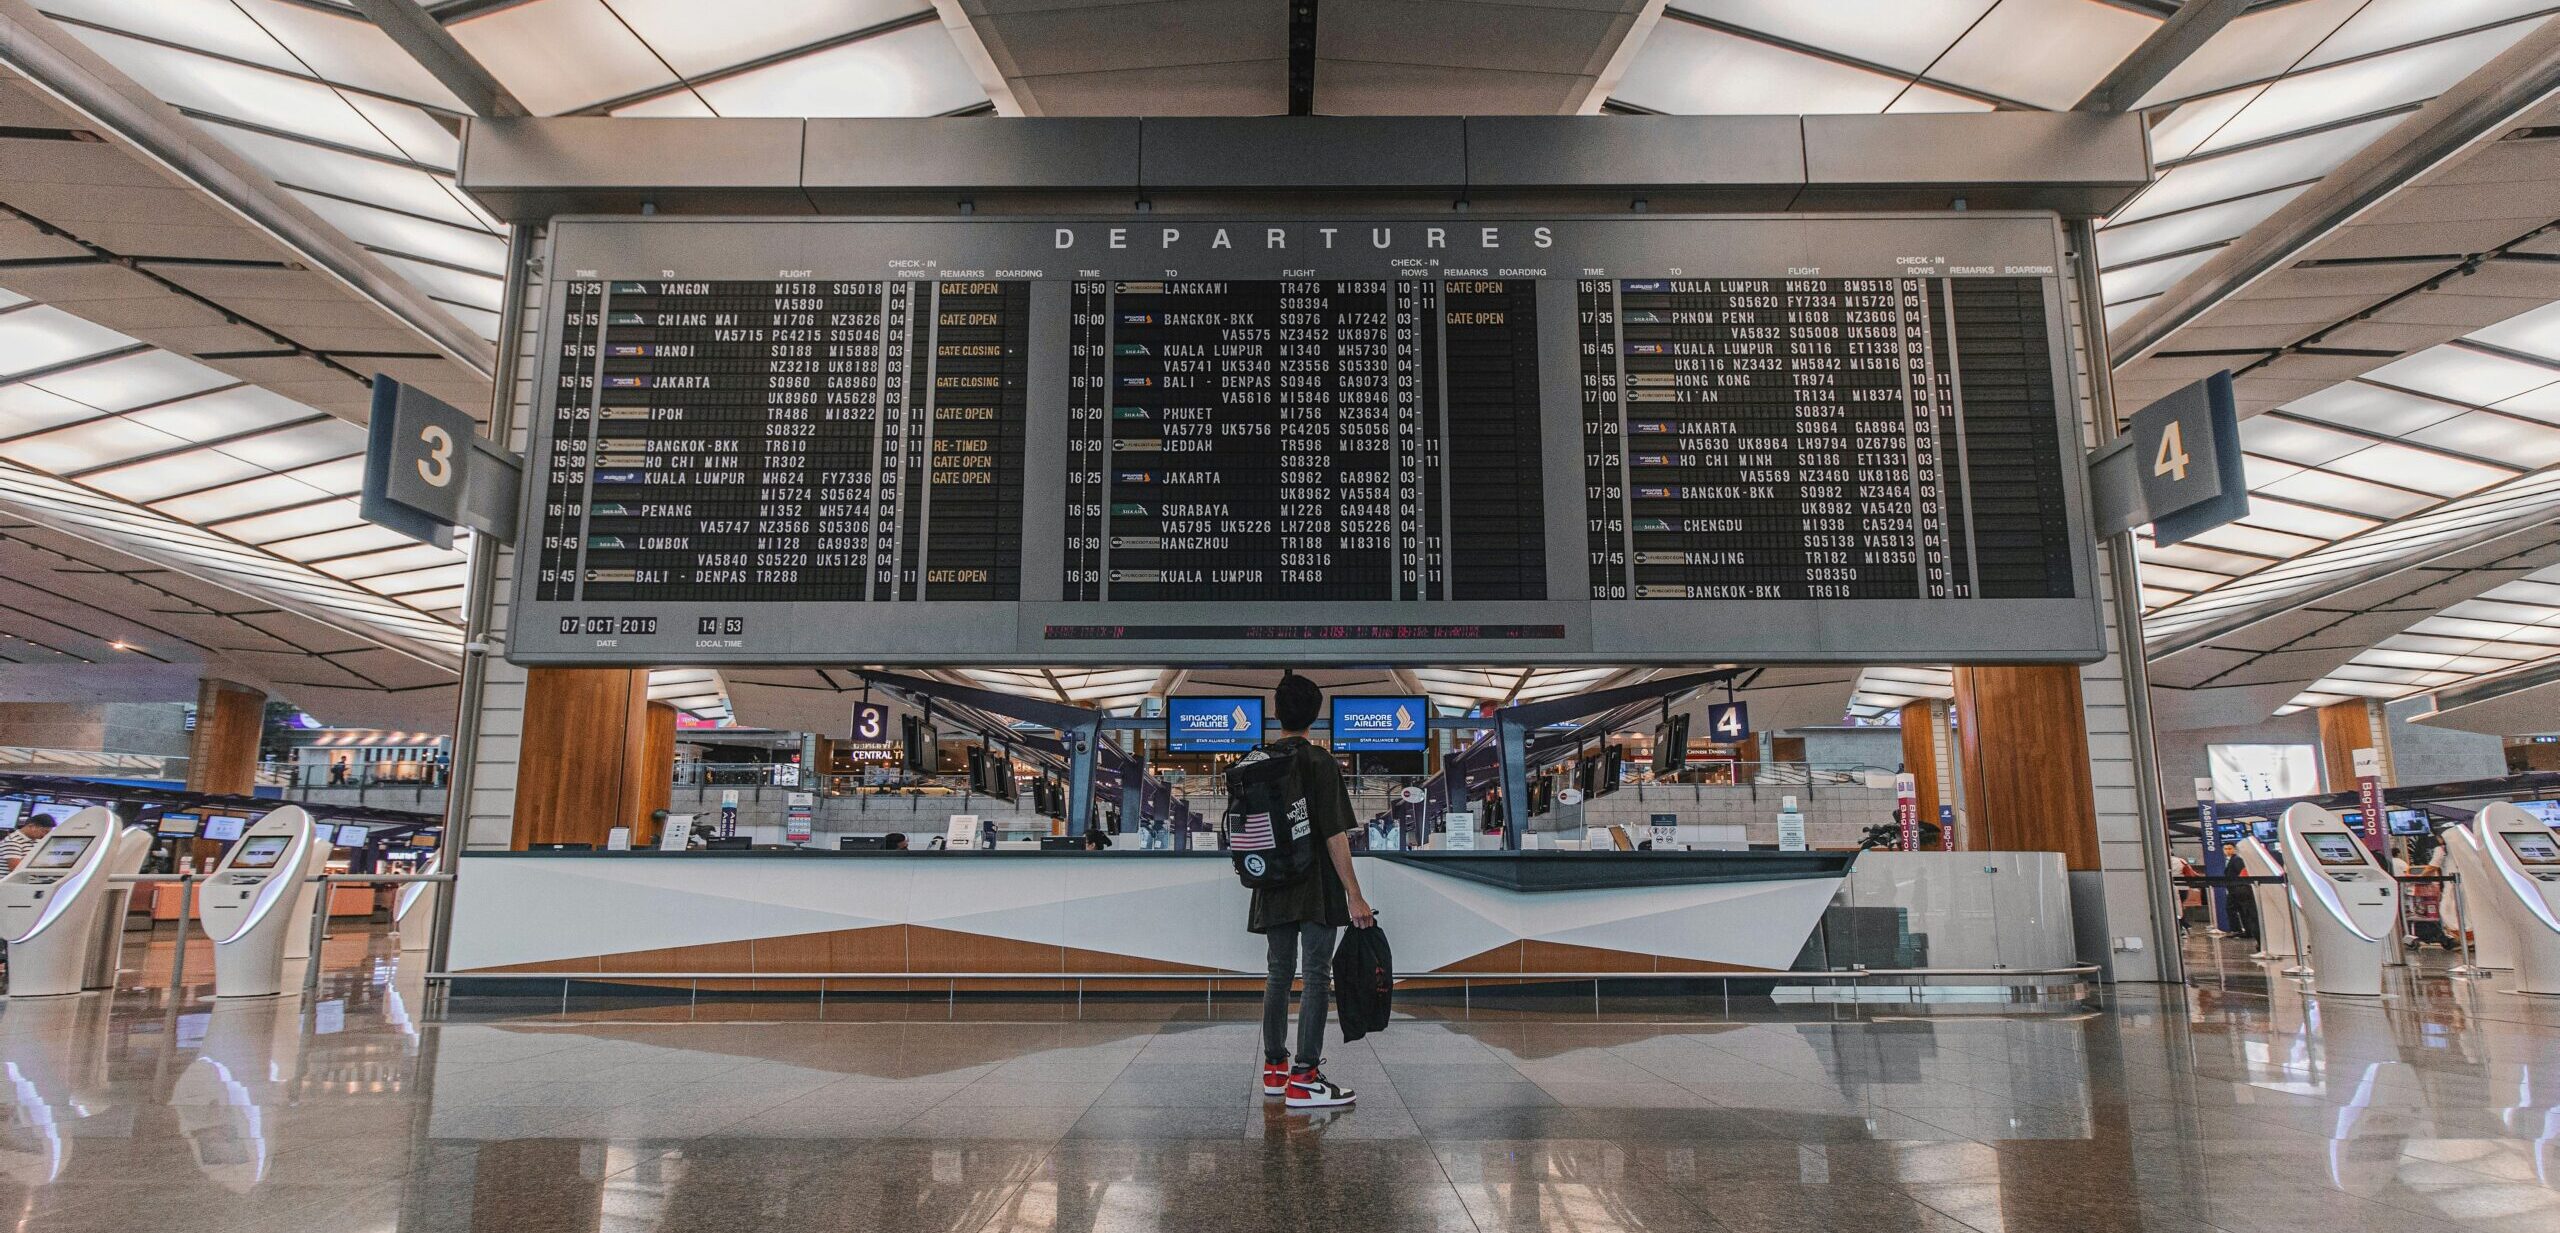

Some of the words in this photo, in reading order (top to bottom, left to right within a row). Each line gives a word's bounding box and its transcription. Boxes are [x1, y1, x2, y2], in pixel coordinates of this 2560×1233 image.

[1056, 227, 1552, 248] DEPARTURES
[1950, 266, 1995, 274] REMARKS
[661, 284, 709, 294] YANGON
[942, 284, 967, 294] GATE
[970, 283, 998, 294] OPEN
[1165, 283, 1227, 294] LANGKAWI
[1447, 282, 1472, 293] GATE
[1475, 282, 1502, 293] OPEN
[1671, 281, 1711, 292] KUALA
[1721, 281, 1768, 292] LUMPUR
[658, 314, 706, 325] CHIANG
[715, 314, 737, 325] MAI
[940, 314, 965, 325] GATE
[969, 314, 996, 325] OPEN
[1165, 314, 1253, 325] BANGKOK-BKK
[1447, 313, 1473, 324] GATE
[1476, 313, 1503, 324] OPEN
[1673, 312, 1713, 323] PHNOM
[1722, 312, 1754, 323] PENH
[655, 346, 694, 356] HANOI
[939, 346, 960, 355] GATE
[963, 346, 1000, 355] CLOSING
[1164, 345, 1204, 356] KUALA
[1215, 345, 1262, 356] LUMPUR
[1674, 344, 1714, 354] KUALA
[1725, 343, 1773, 354] LUMPUR
[653, 377, 709, 388] JAKARTA
[937, 378, 959, 387] GATE
[961, 377, 998, 386] CLOSING
[1164, 376, 1193, 387] BALI
[1222, 376, 1270, 387] DENPAS
[1676, 375, 1708, 386] HONG
[1718, 375, 1750, 386] KONG
[652, 409, 683, 420] IPOH
[936, 408, 961, 419] GATE
[965, 408, 993, 419] OPEN
[1164, 408, 1212, 419] PHUKET
[1679, 423, 1736, 434] JAKARTA
[648, 440, 738, 451] BANGKOK-BKK
[934, 440, 987, 451] RE-TIMED
[1164, 440, 1211, 451] JEDDAH
[2154, 420, 2190, 482] 4
[416, 425, 453, 488] 3
[646, 457, 661, 467] HO
[672, 456, 693, 467] CHI
[705, 456, 737, 468] MINH
[934, 456, 960, 467] GATE
[963, 456, 991, 467] OPEN
[1680, 455, 1695, 466] HO
[1706, 455, 1727, 466] CHI
[1739, 454, 1772, 466] MINH
[645, 473, 685, 484] KUALA
[696, 472, 744, 484] LUMPUR
[933, 472, 959, 483] GATE
[962, 472, 990, 483] OPEN
[1163, 472, 1220, 484] JAKARTA
[1682, 487, 1774, 498] BANGKOK-BKK
[642, 505, 691, 516] PENANG
[1162, 504, 1228, 516] SURABAYA
[1684, 520, 1742, 531] CHENGDU
[640, 538, 688, 549] LOMBOK
[1162, 537, 1228, 549] HANGZHOU
[1686, 553, 1744, 564] NANJING
[637, 571, 667, 582] BALI
[696, 571, 746, 582] DENPAS
[928, 571, 955, 582] GATE
[958, 570, 986, 582] OPEN
[1161, 571, 1202, 582] KUALA
[1213, 570, 1262, 582] LUMPUR
[1688, 586, 1780, 598] BANGKOK-BKK
[561, 620, 657, 632] 07-OCT-2019
[860, 708, 880, 738] 3
[1717, 707, 1742, 736] 4
[2361, 782, 2377, 836] Bag-Drop
[1901, 804, 1910, 851] Bag-Dro
[1909, 804, 1918, 851] Bag-Dro
